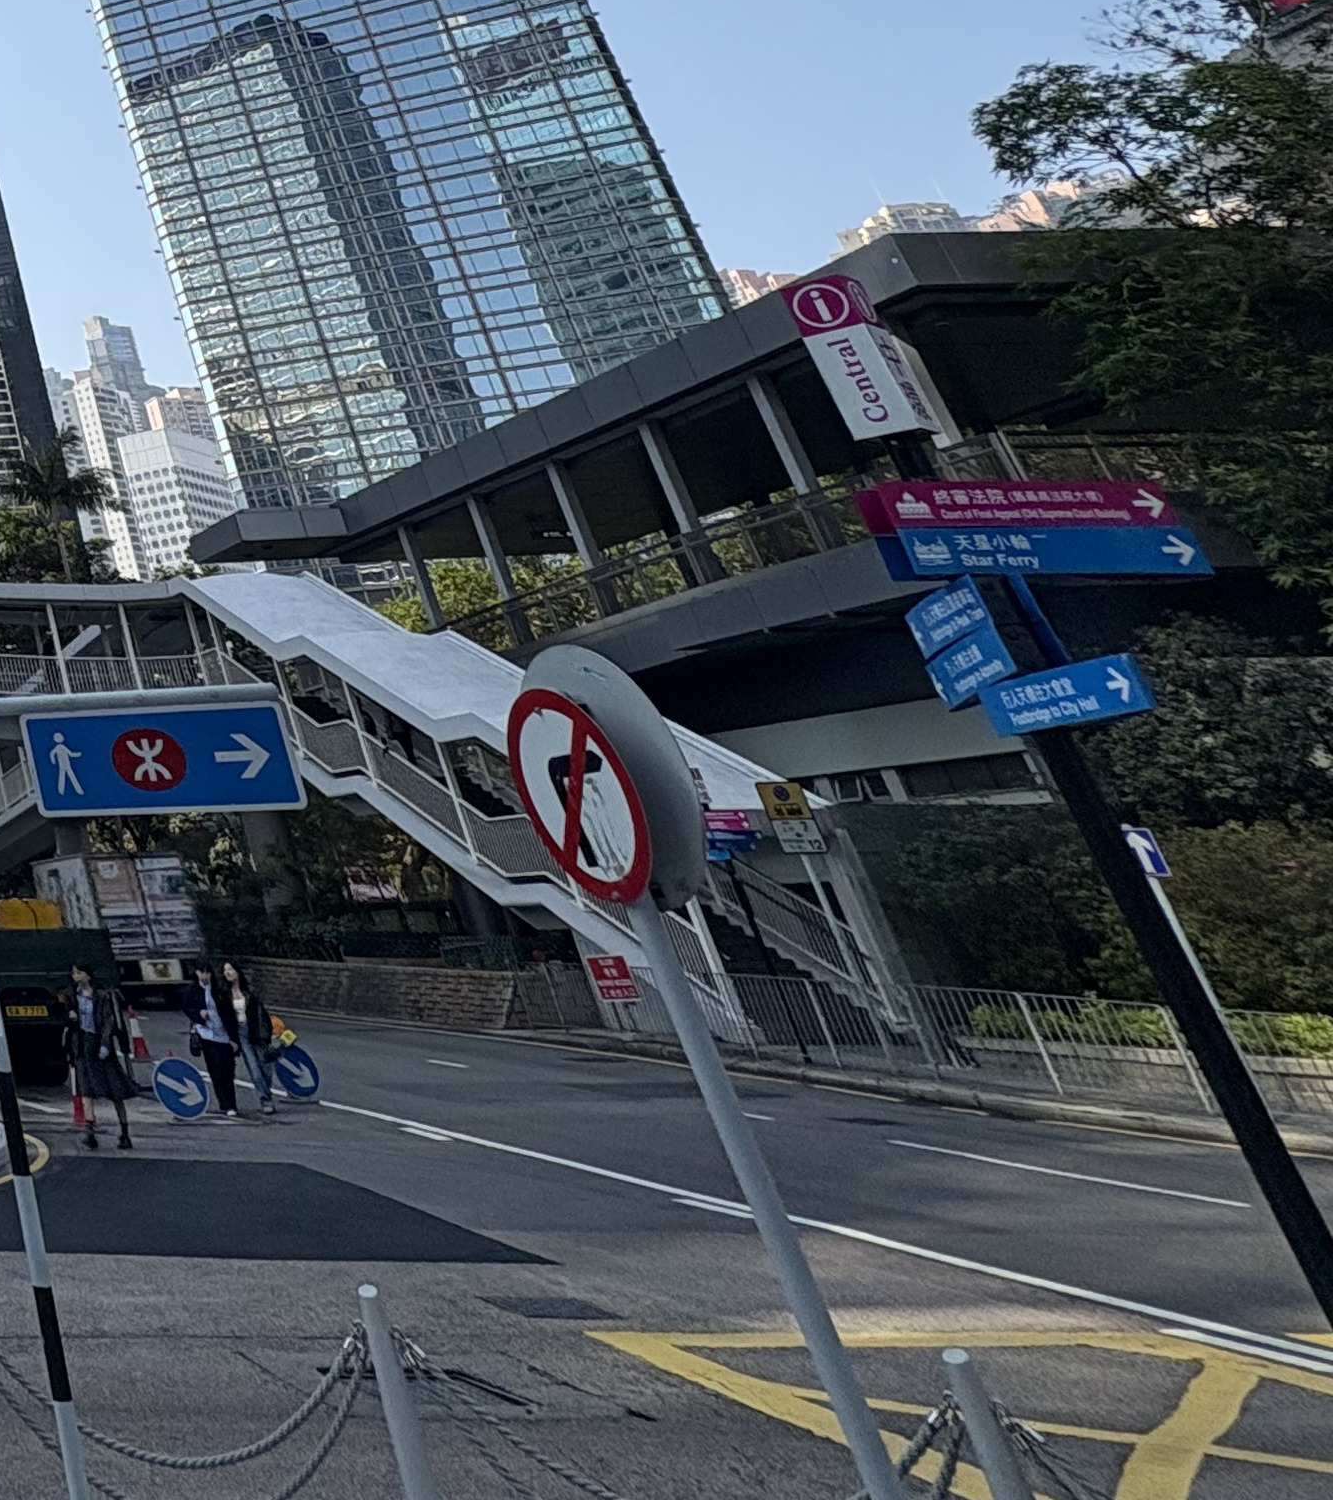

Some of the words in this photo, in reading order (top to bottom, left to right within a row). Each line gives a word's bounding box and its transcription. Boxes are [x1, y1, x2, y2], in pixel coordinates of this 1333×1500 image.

[826, 337, 889, 423] Central
[953, 534, 1032, 551] 天星小輪
[961, 554, 994, 567] Star
[998, 554, 1040, 569] Ferry
[1007, 707, 1052, 726] Footbridge
[1049, 705, 1062, 718] to
[1059, 700, 1081, 717] City
[1076, 695, 1101, 712] Hall
